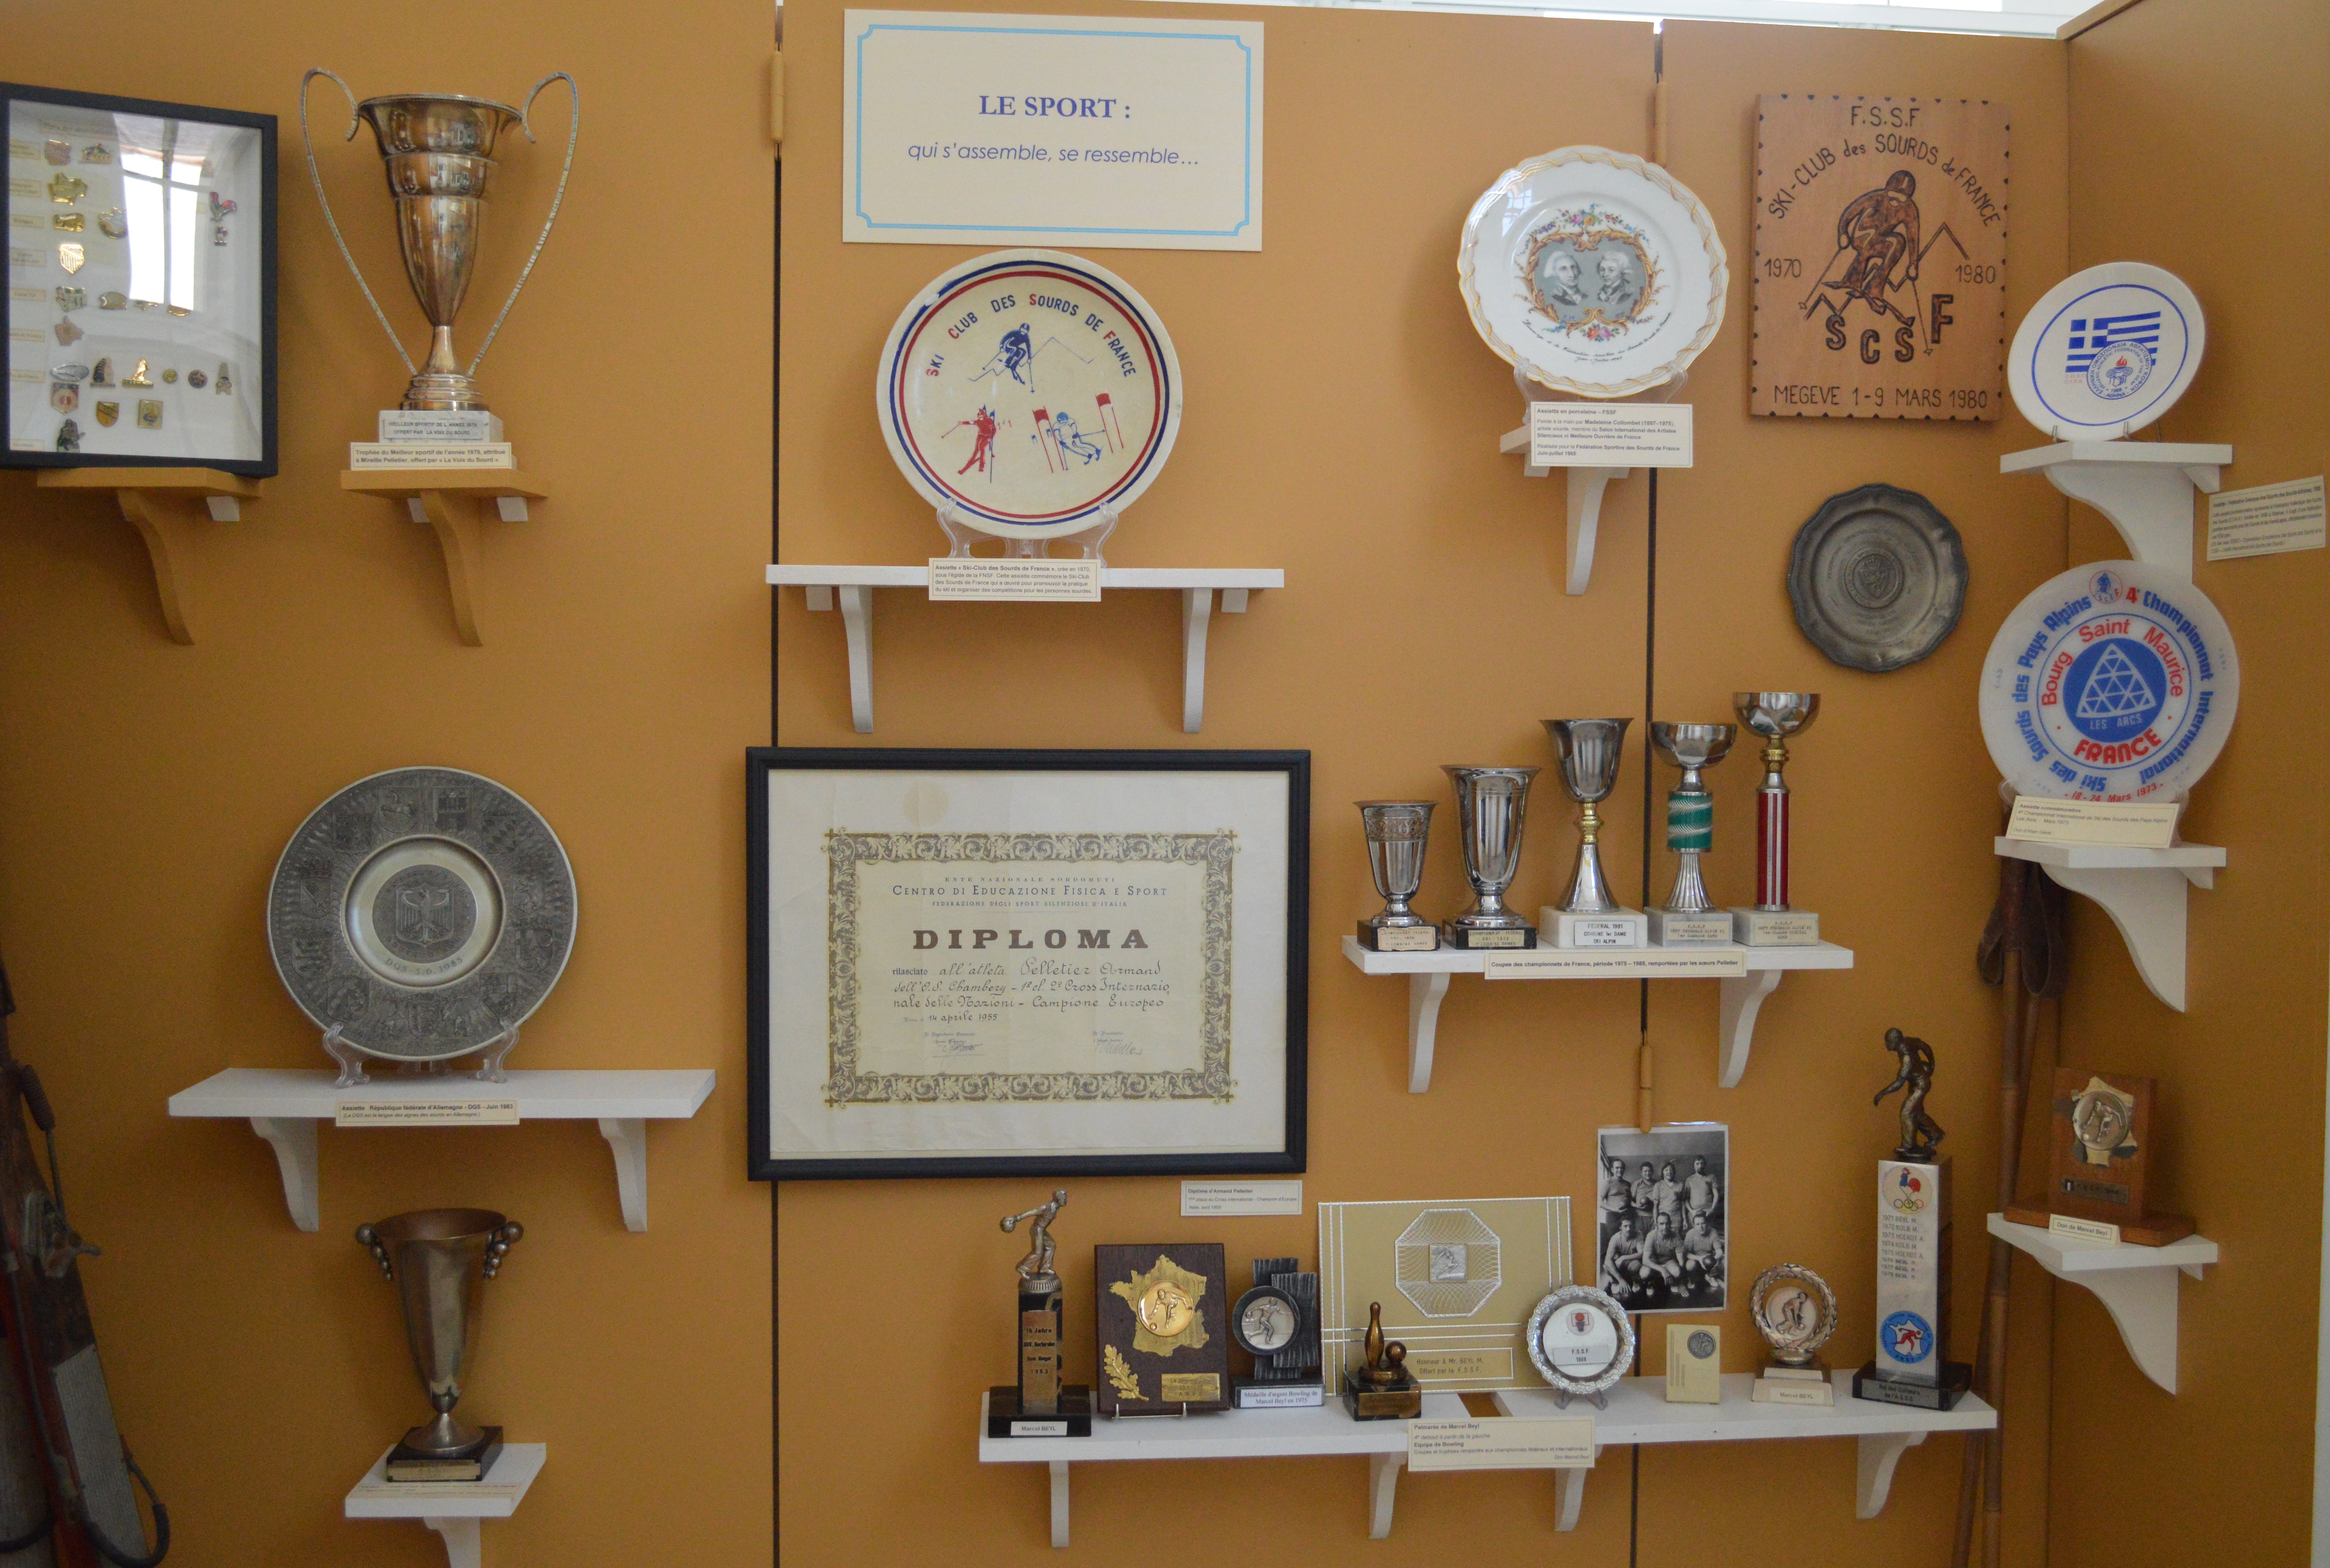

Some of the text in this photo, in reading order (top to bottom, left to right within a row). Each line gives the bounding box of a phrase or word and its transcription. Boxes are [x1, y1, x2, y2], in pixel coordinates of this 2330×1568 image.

[979, 95, 1015, 115] LE
[1025, 96, 1116, 118] SPORT
[1851, 106, 1920, 127] F.S.S.F
[908, 141, 938, 161] qui
[1059, 149, 1078, 161] se
[1843, 138, 1866, 157] des
[1875, 133, 1938, 165] SOURDS
[1942, 158, 1955, 174] de
[1954, 167, 2001, 227] FRANCE
[1764, 258, 1801, 278] 1970
[1955, 265, 1996, 285] 1980
[926, 294, 1136, 377] SKI CLUB DES SOURDS DE FRANCE
[1774, 385, 1840, 405] MEGEVE
[1896, 387, 1941, 407] MARS
[1949, 389, 1987, 408] 1980
[2043, 596, 2092, 632] Alpins
[2017, 631, 2048, 668] Pays
[2041, 618, 2184, 706] Bourg Saint Maurice
[2011, 675, 2030, 702] des
[2090, 713, 2142, 730] LES ARCS
[2015, 710, 2049, 762] Sourds
[2074, 728, 2162, 764] FRANCE
[2049, 760, 2077, 783] des
[2107, 783, 2157, 802] Mars 1973
[913, 929, 1148, 949] DIPLOMA
[1021, 957, 1090, 975] Pelletier
[1033, 993, 1163, 1012] Campione Europeo
[941, 1010, 973, 1024] aprile
